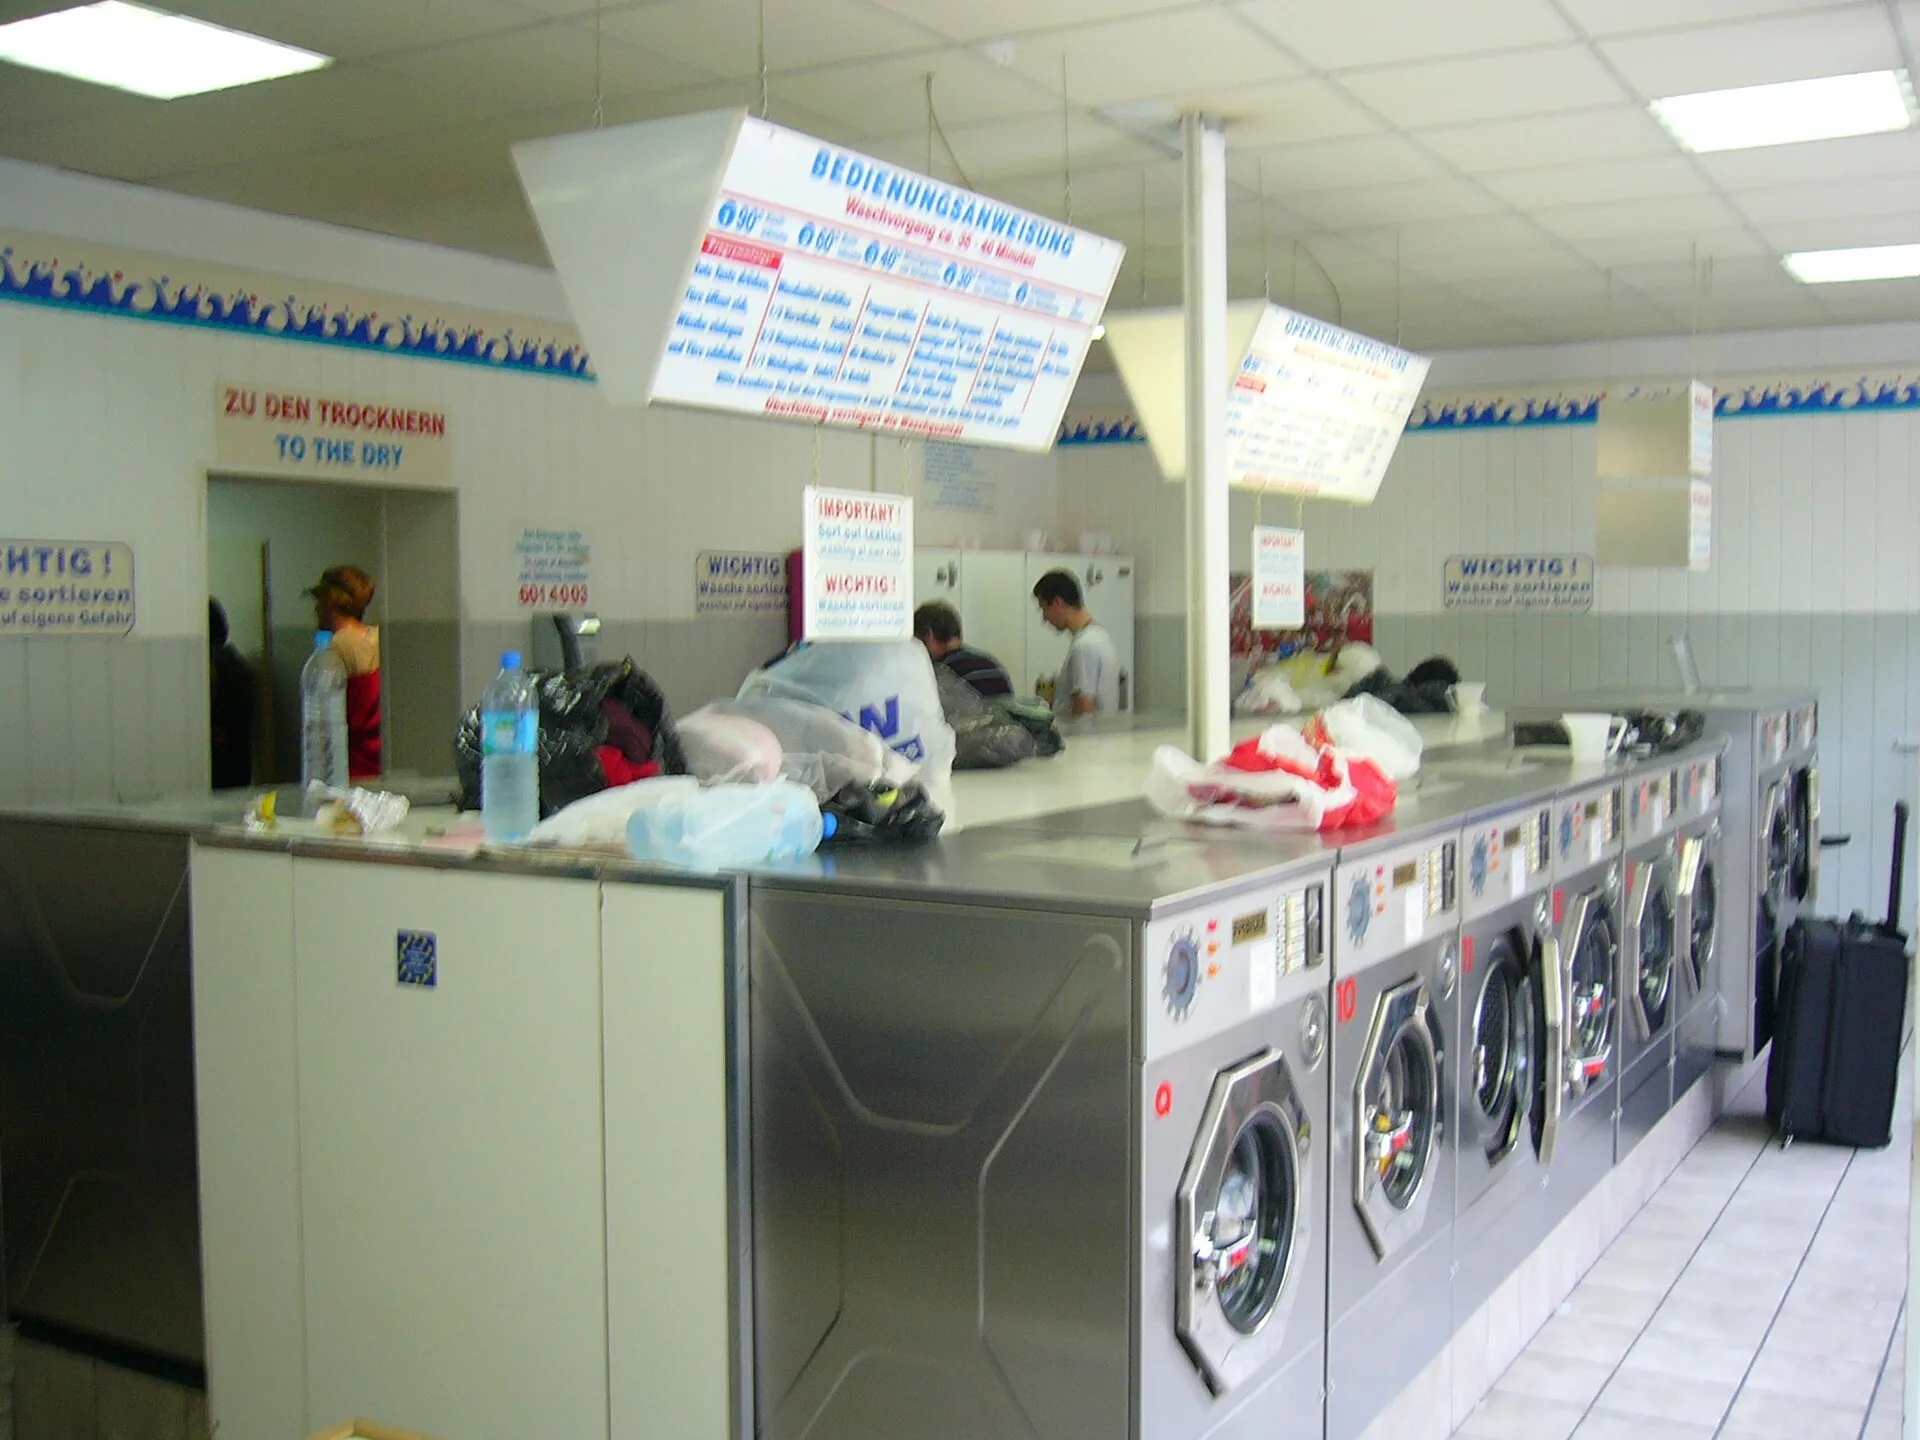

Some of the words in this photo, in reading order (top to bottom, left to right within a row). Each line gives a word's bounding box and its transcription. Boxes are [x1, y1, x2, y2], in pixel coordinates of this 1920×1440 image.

[811, 148, 1076, 259] BEDIENUNGSANWEISUNG
[844, 195, 935, 242] Waschvorgang
[994, 241, 1037, 268] Minuten
[1285, 315, 1344, 351] OPERATING
[1345, 335, 1410, 373] INSTRUCTIONS
[224, 387, 257, 417] ZU
[265, 392, 311, 422] DEN
[318, 398, 445, 435] TROCKNERN
[275, 432, 306, 462] TO
[313, 436, 355, 467] THE
[362, 441, 404, 469] DRY
[19, 583, 131, 604] sortieren
[22, 610, 75, 629] eigene
[1336, 976, 1357, 1025] 10
